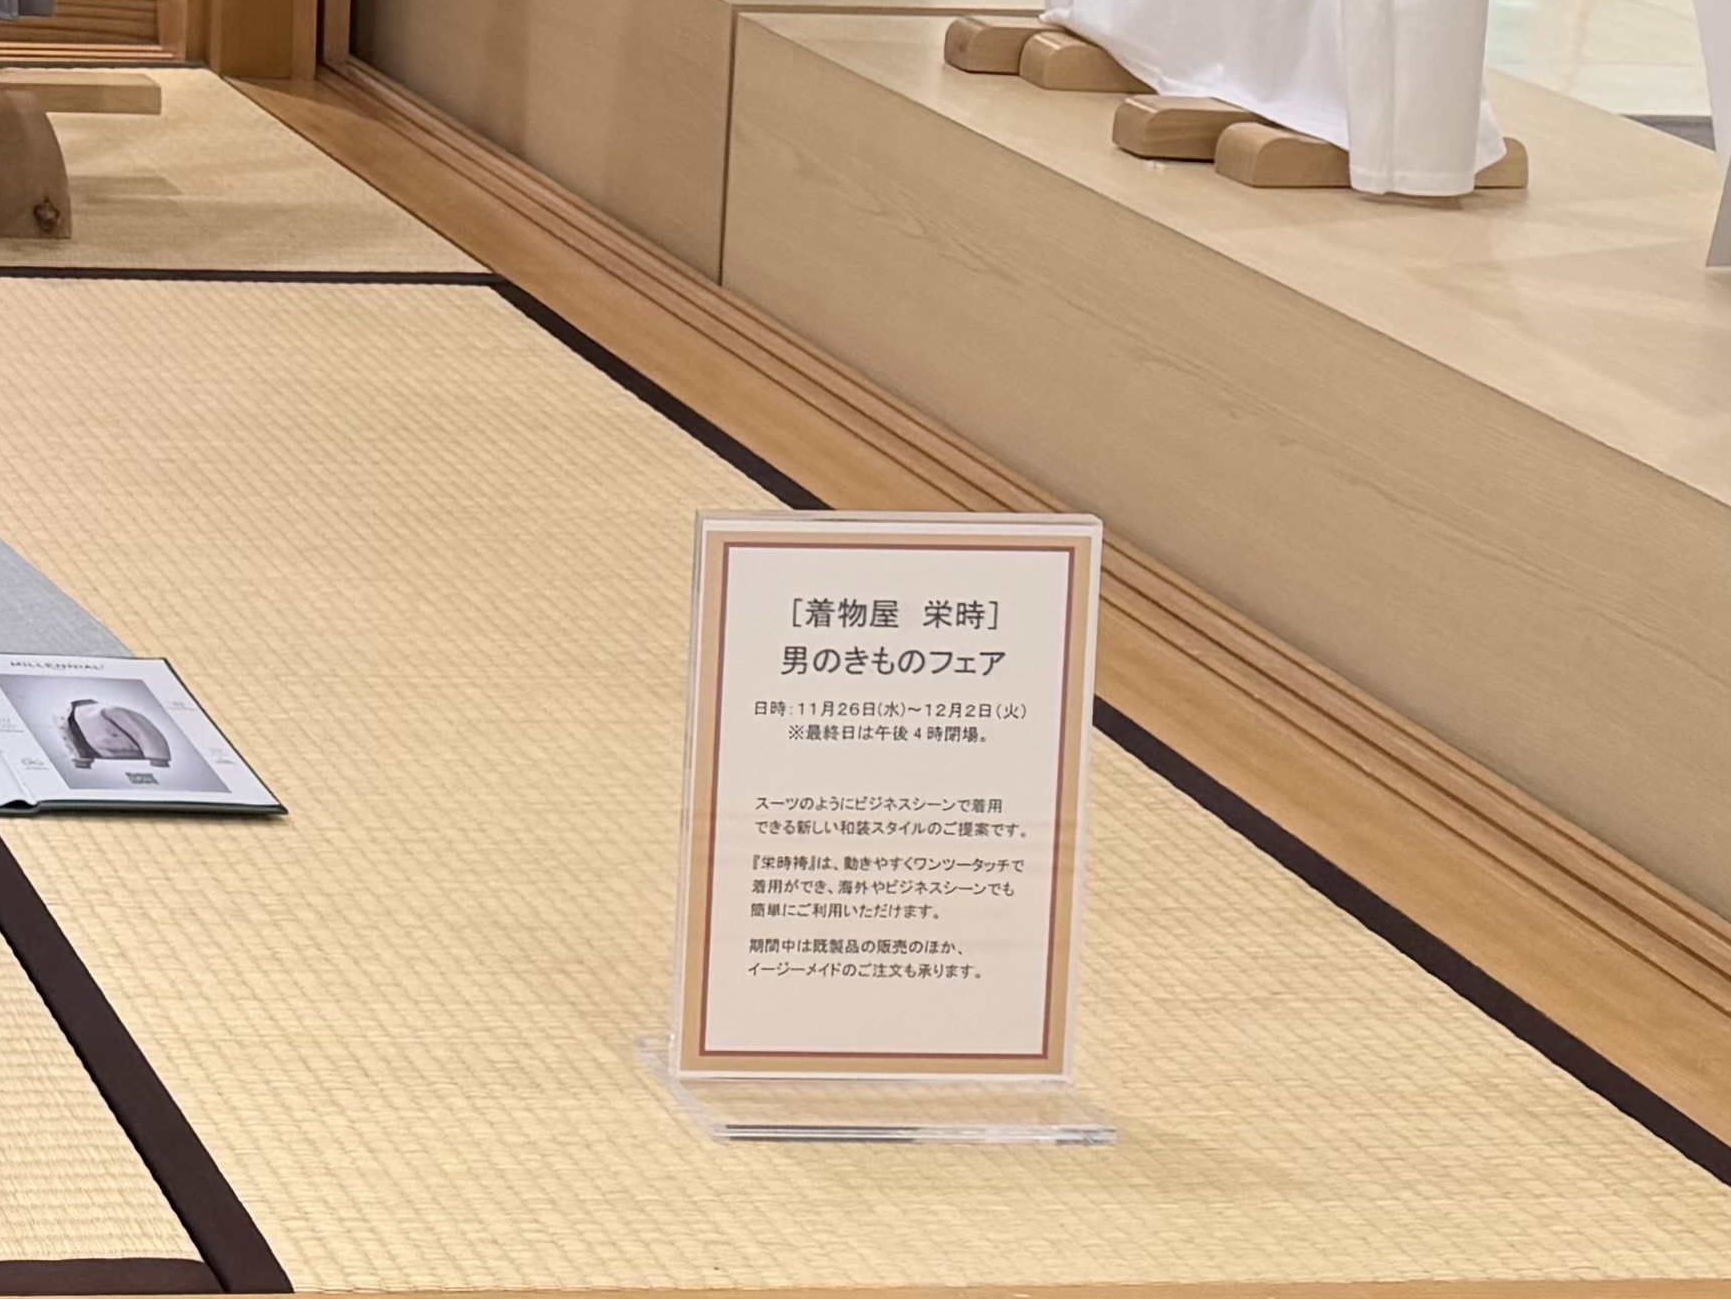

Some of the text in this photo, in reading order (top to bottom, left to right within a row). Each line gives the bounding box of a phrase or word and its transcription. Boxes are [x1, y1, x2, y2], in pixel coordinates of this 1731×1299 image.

[780, 645, 1006, 676] 男のきものフェア
[755, 796, 1003, 814] スーツのようにビジネスシーンで着用
[755, 820, 1027, 838] できる新しい和装スタイルのご提案です。
[752, 854, 1025, 873] 『栄時袴』は、動きやすくワンツータッチで
[751, 879, 1015, 897] 着用ができ、海外やビジネスシーンでも
[750, 903, 940, 920] 簡単にご利用いただけます。
[748, 939, 963, 955] 期間中は既製品の販売のほか、
[748, 962, 982, 980] イージーメイドのご注文も承ります。
